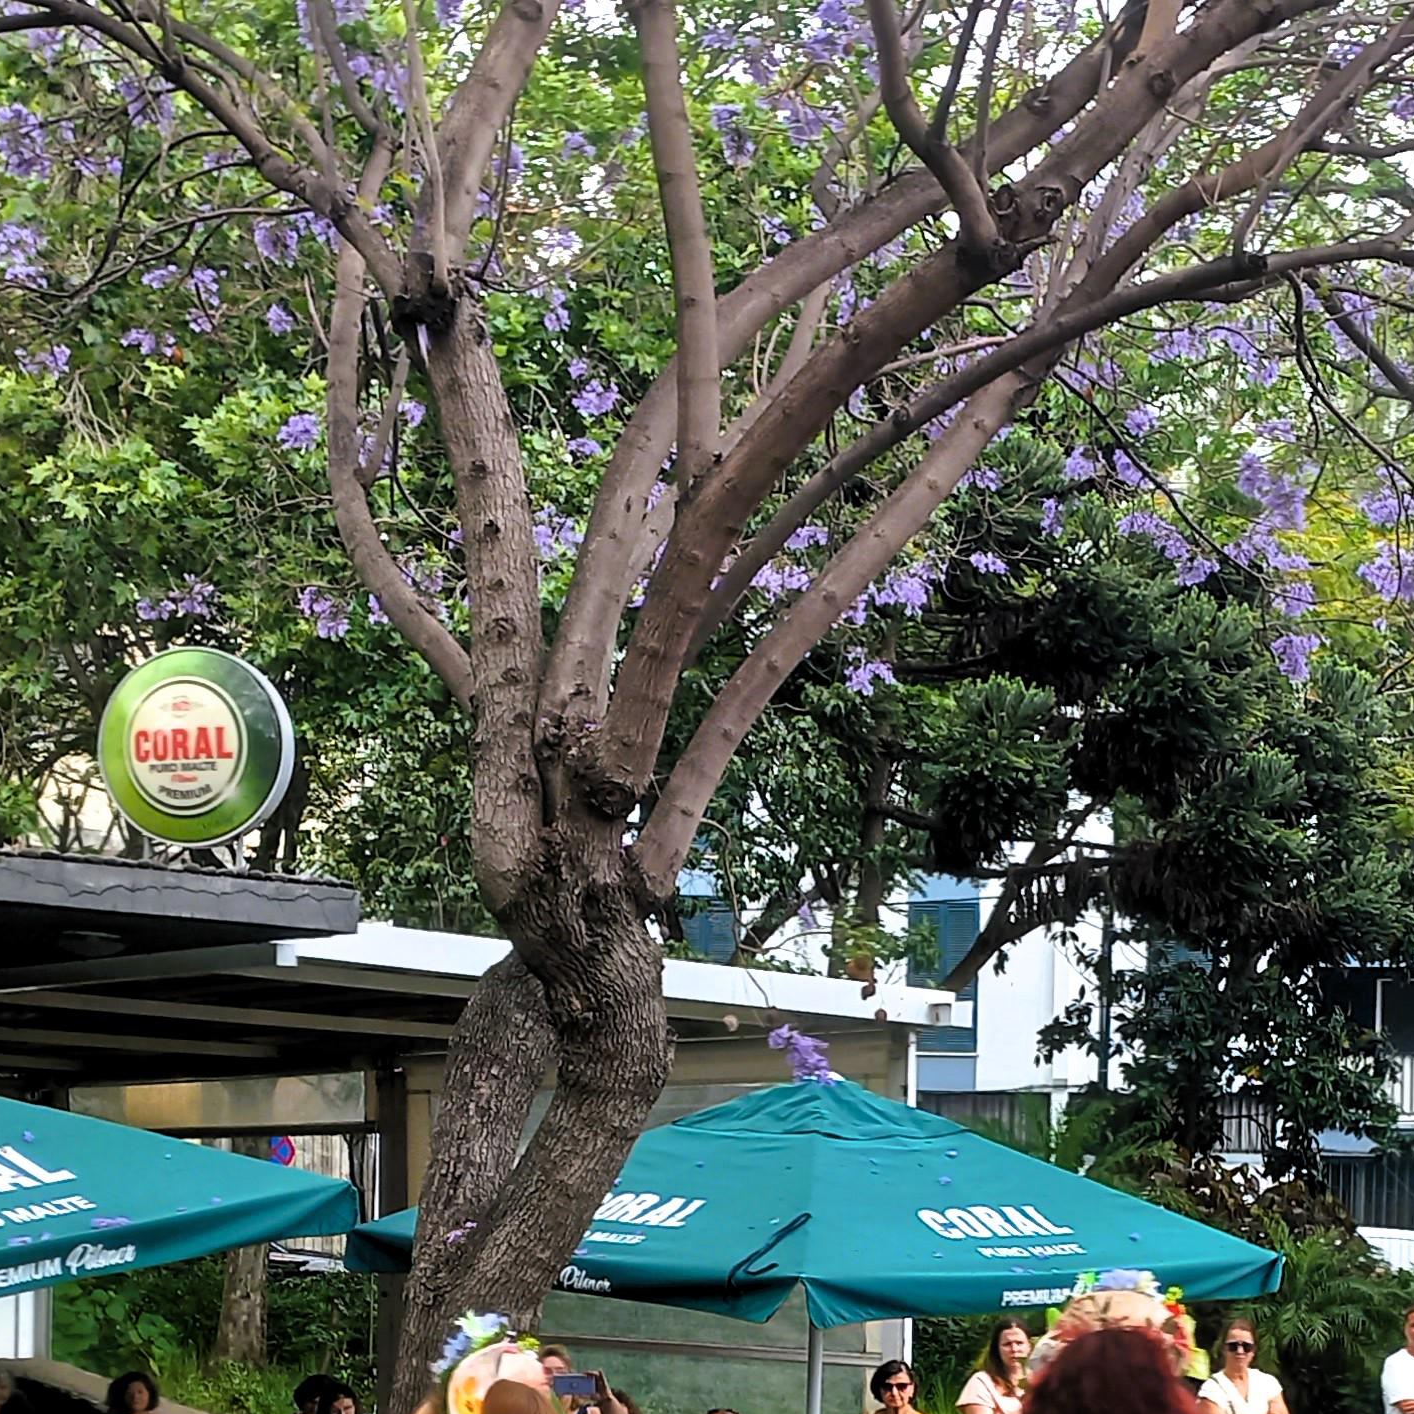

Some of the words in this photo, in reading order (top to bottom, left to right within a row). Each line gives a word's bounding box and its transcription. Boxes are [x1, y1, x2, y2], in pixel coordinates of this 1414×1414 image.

[134, 726, 234, 764] CORAL
[0, 1195, 98, 1225] MALTE
[592, 1192, 708, 1229] ORAL
[916, 1204, 1076, 1241] CORAL
[65, 1243, 138, 1276] Pilsner
[976, 1246, 1031, 1258] PURO
[559, 1264, 613, 1293] Pilsner
